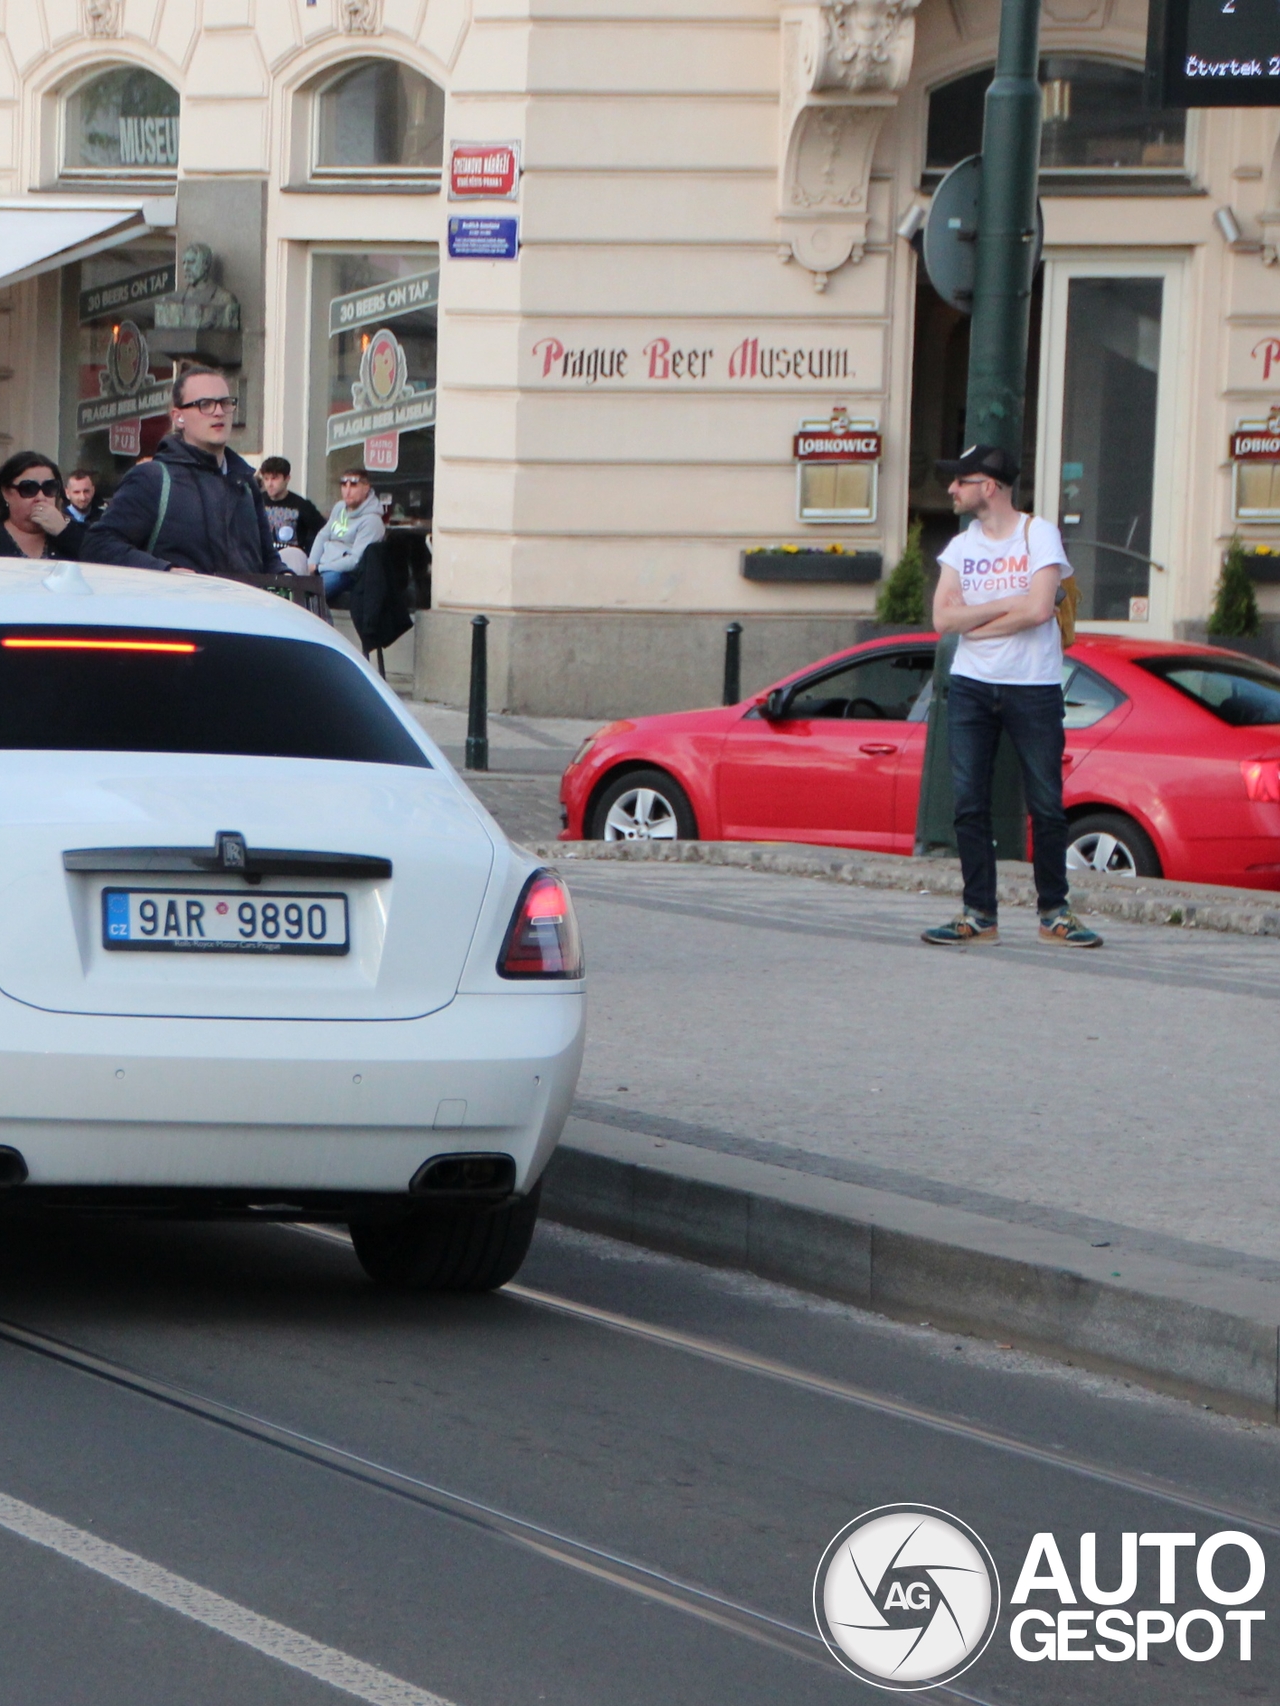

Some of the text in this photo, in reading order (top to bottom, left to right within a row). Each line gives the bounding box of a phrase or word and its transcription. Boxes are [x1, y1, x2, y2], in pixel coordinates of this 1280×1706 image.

[1186, 55, 1262, 76] Čtvrtek
[88, 294, 101, 312] 30
[102, 283, 129, 306] BEERS
[131, 278, 148, 298] ON
[340, 303, 354, 323] 30
[356, 292, 386, 318] BEERS
[387, 288, 407, 309] ON
[532, 337, 629, 385] Prague
[643, 337, 714, 379] Beer
[82, 401, 117, 425] PRAGUE
[118, 397, 137, 415] BEER
[333, 402, 434, 440] PRAGUE BEER MUSEUM
[114, 435, 136, 450] PUB
[370, 438, 393, 448] GASTRO
[798, 438, 878, 455] LOBKOWICZ
[370, 450, 393, 465] PUB
[963, 555, 1028, 575] BOOM
[963, 574, 1028, 592] events
[110, 924, 128, 935] CZ
[139, 899, 327, 940] 9AR 9890
